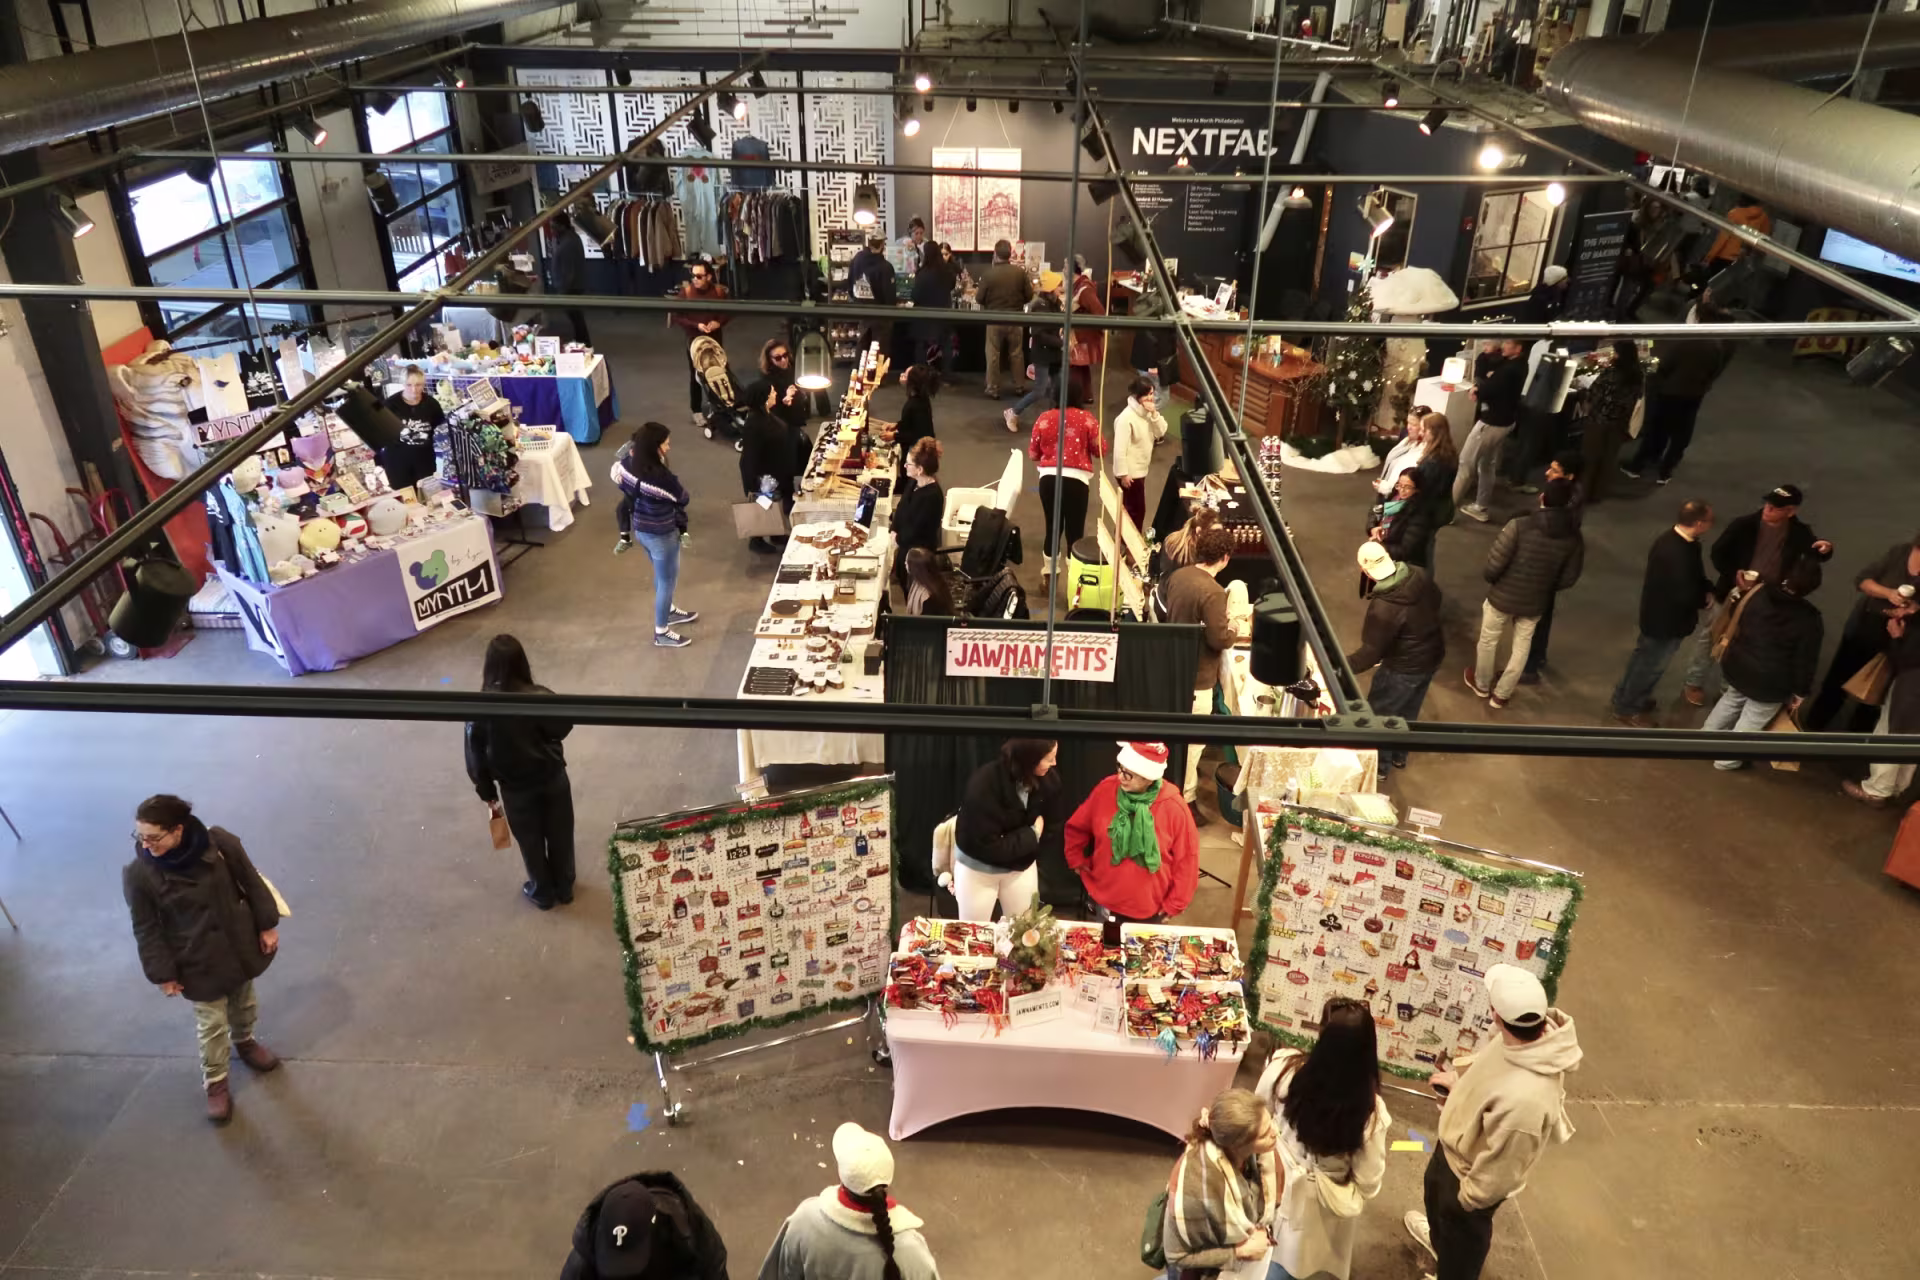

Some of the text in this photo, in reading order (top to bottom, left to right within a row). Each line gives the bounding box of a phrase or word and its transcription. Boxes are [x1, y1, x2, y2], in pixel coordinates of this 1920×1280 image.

[417, 568, 489, 617] MYNTH
[954, 643, 1108, 672] JAWNAMENTS
[1015, 1000, 1060, 1016] JAWNAMENTS.COM
[612, 1225, 628, 1247] P
